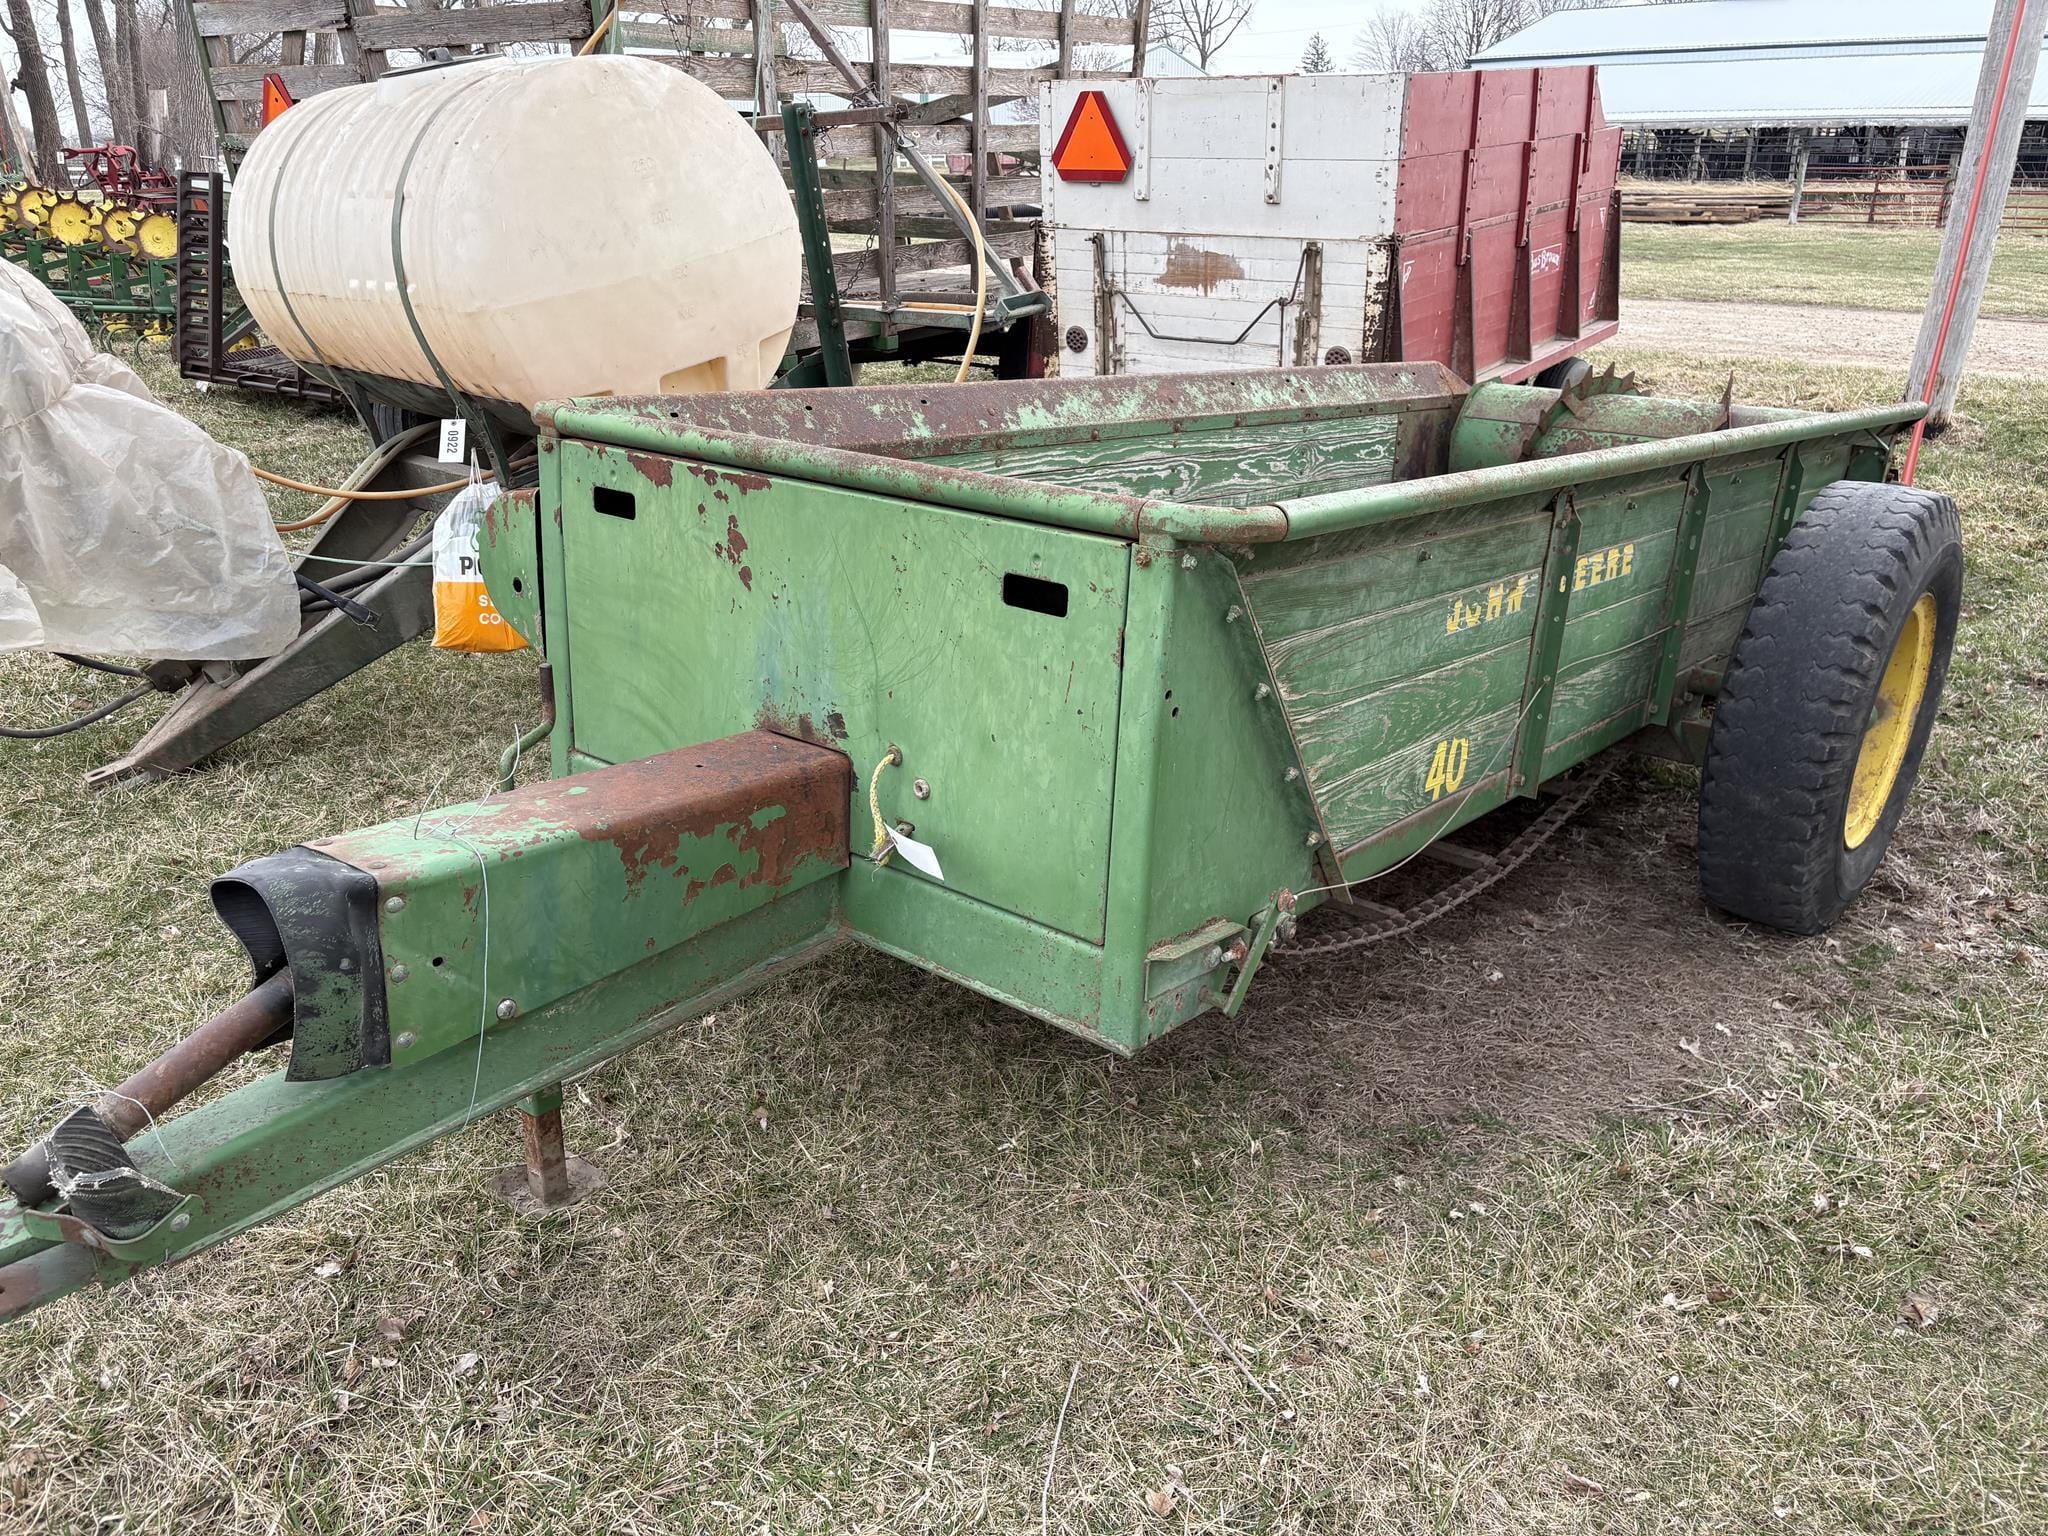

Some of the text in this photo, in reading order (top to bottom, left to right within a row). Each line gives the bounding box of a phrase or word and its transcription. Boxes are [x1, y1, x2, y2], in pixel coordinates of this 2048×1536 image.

[446, 430, 459, 454] 0922
[1559, 544, 1635, 593] EERE
[479, 612, 502, 625] CO
[1424, 736, 1469, 802] 40
